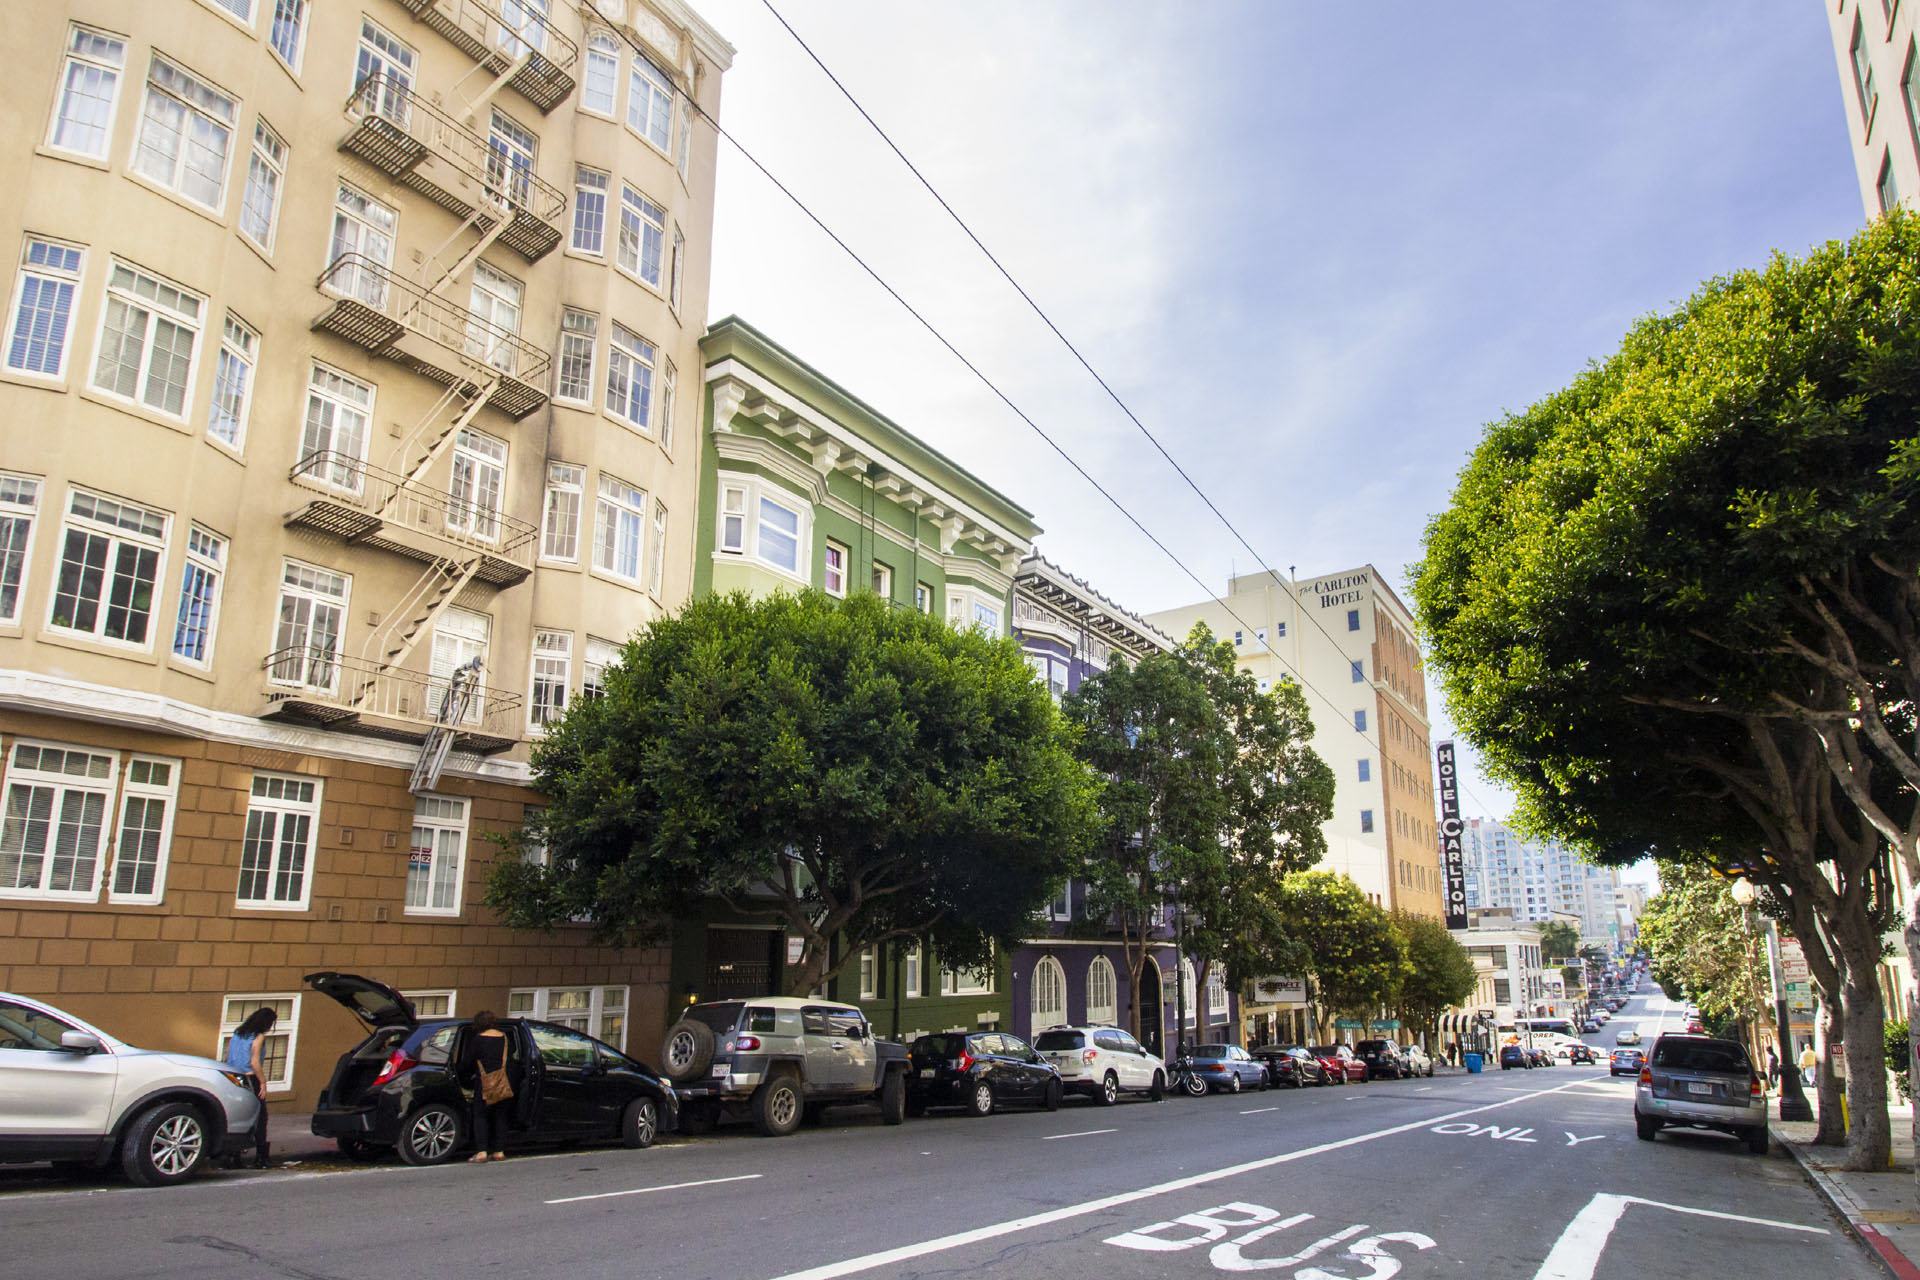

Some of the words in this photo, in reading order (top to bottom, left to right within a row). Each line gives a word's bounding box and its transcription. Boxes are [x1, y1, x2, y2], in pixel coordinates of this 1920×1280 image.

[1314, 573, 1369, 595] CARLTON
[1320, 590, 1364, 609] HOTEL
[1439, 750, 1457, 814] HOTEL
[1441, 819, 1465, 916] CARLTON
[1430, 1122, 1606, 1146] ONLY
[1102, 1201, 1438, 1280] BUS
